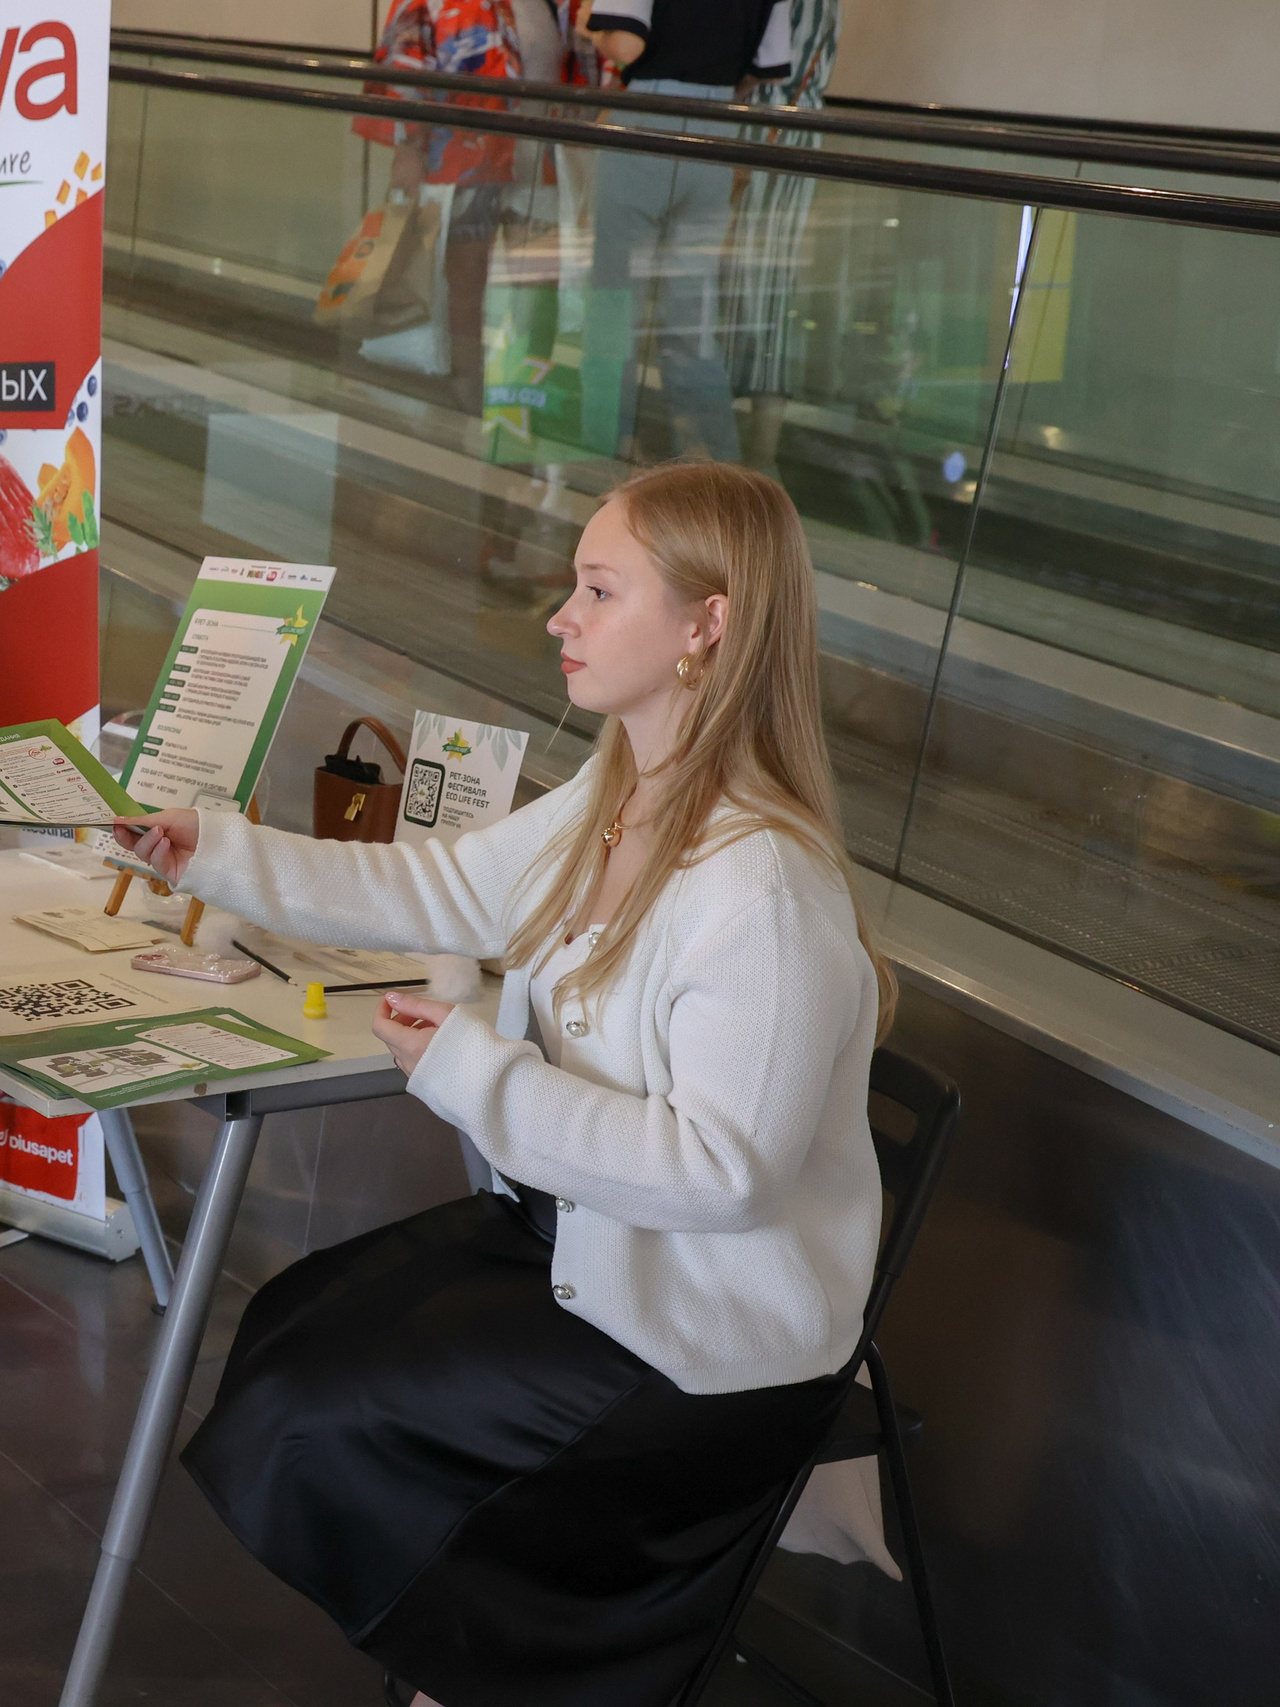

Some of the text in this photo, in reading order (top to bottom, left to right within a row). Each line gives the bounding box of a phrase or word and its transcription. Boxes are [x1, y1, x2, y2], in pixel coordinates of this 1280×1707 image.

[447, 782, 487, 797] ФЕСТИВАЛЯ
[445, 791, 490, 809] ECO LIFE FEST
